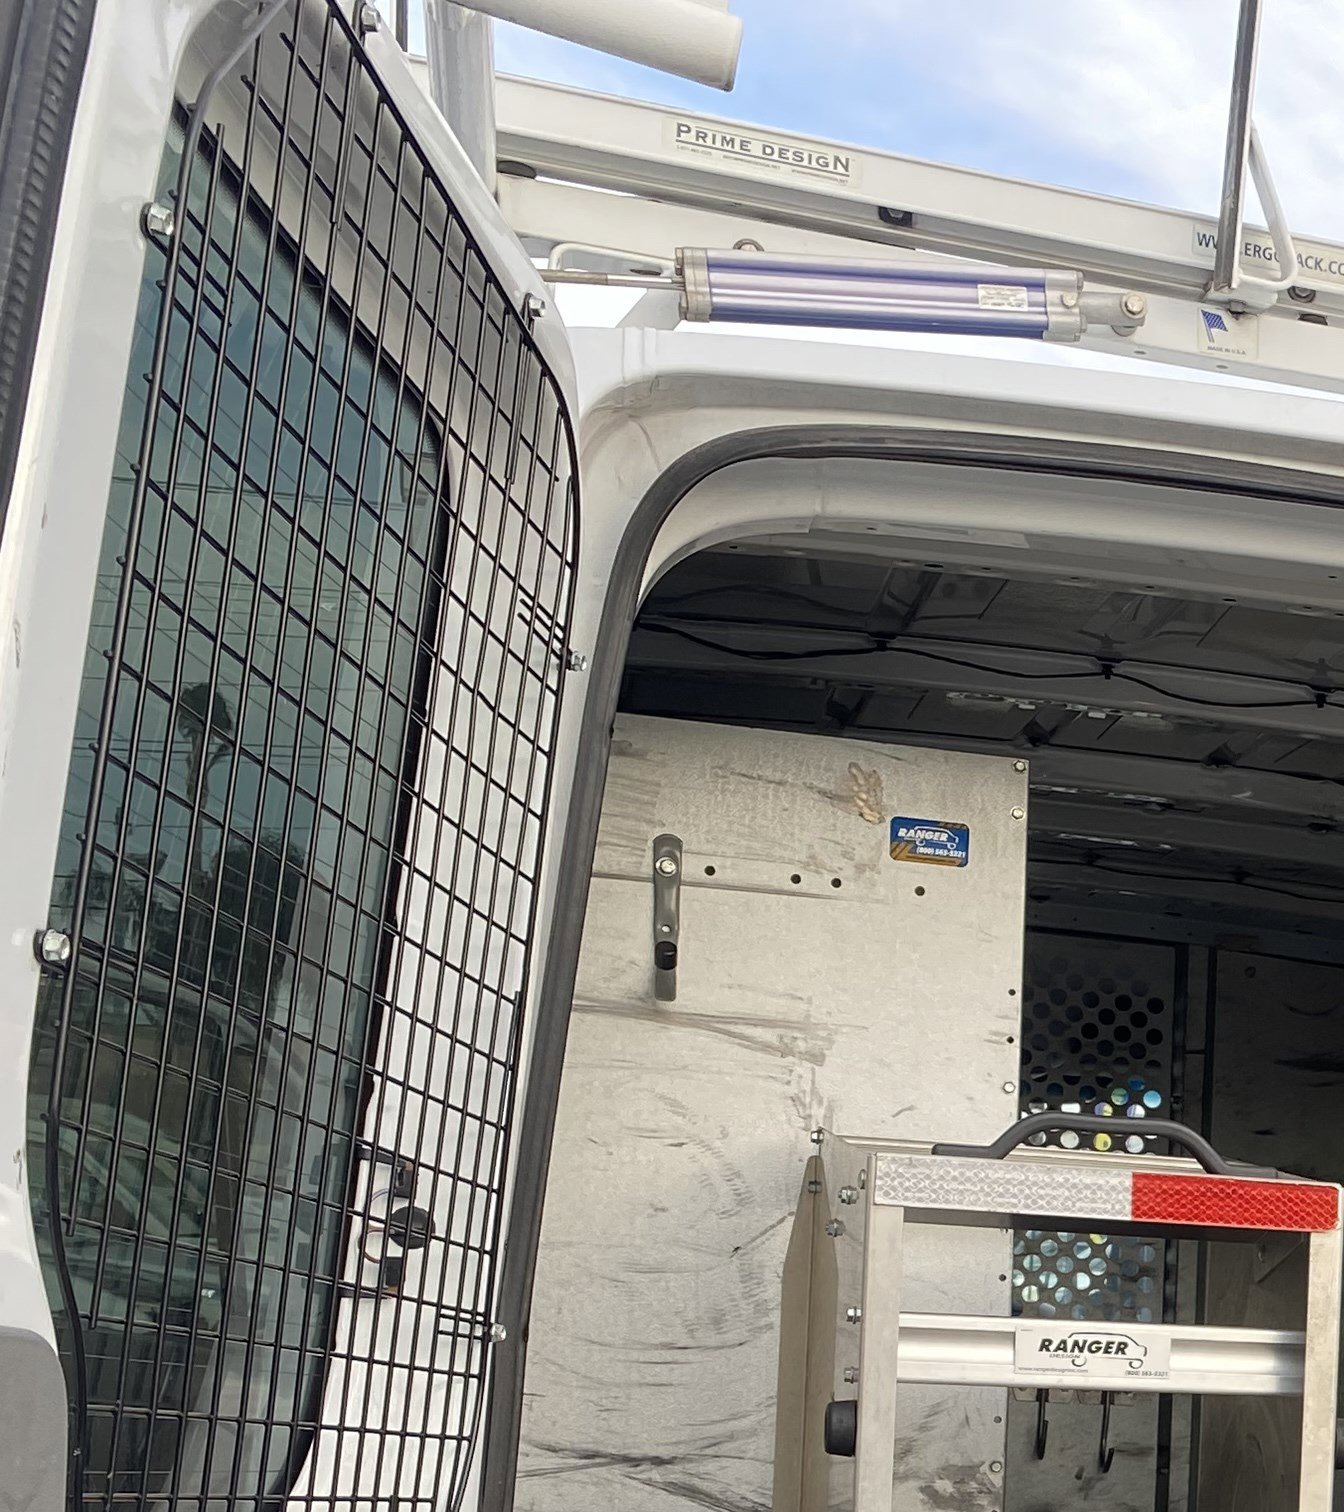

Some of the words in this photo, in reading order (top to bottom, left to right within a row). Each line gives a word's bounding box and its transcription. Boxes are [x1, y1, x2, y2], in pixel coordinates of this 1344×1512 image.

[676, 122, 751, 153] PRIME
[761, 143, 850, 173] DESIGN
[897, 828, 949, 842] RANGER
[1038, 1338, 1129, 1356] RANGER
